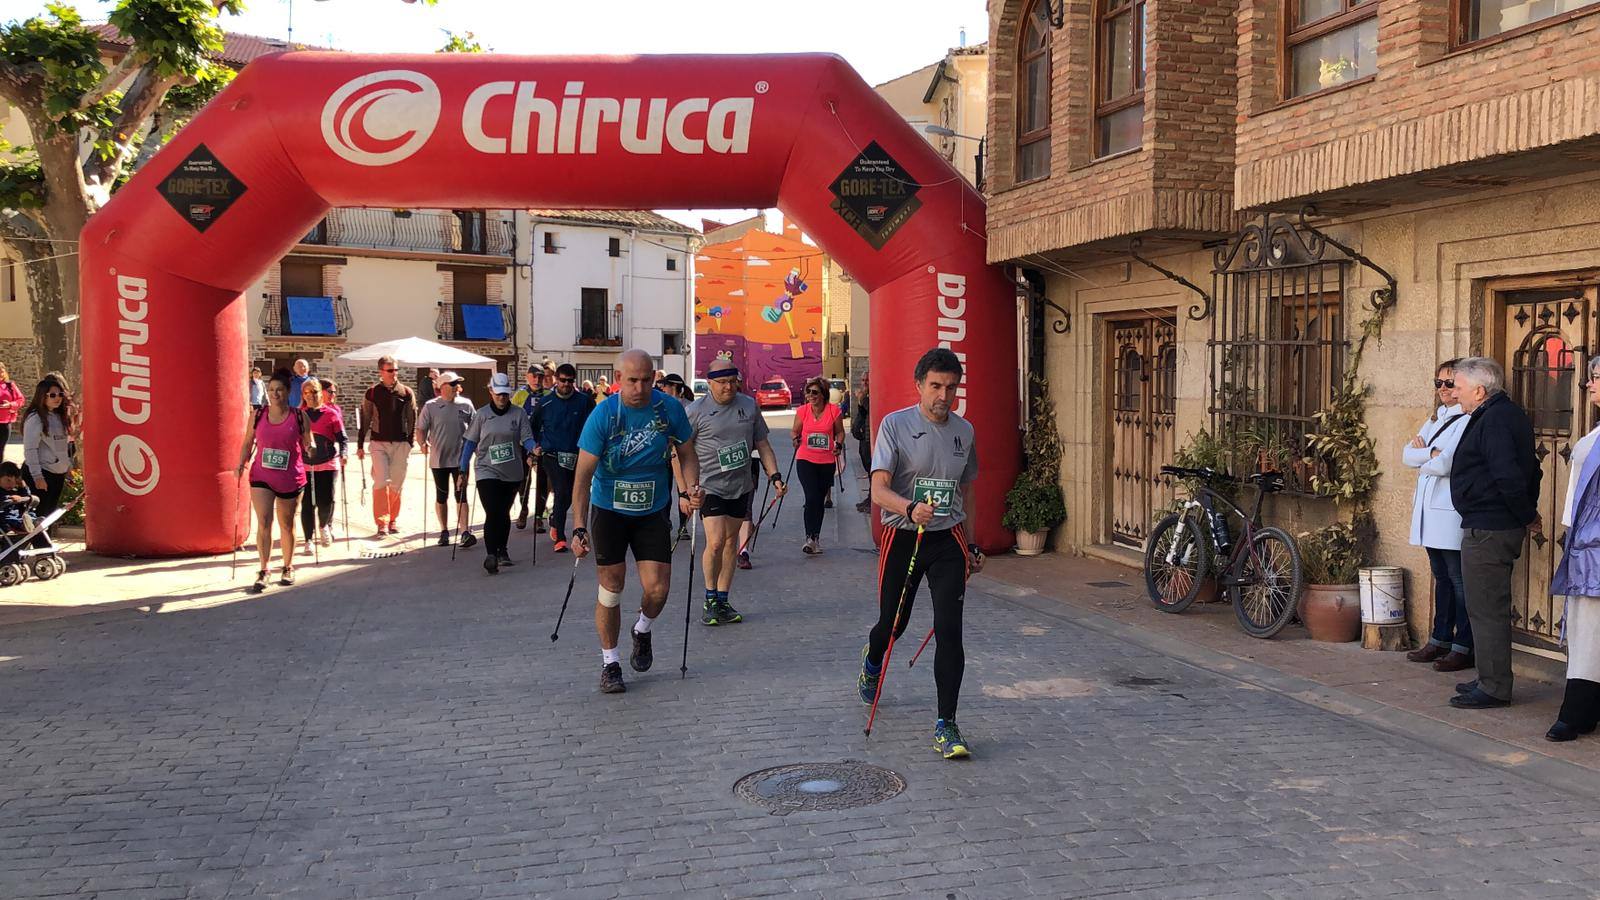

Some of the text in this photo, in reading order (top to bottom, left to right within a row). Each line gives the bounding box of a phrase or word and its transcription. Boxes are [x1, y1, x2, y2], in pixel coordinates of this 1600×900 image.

[460, 80, 755, 155] Chiruca
[840, 179, 906, 196] GORE-TEX
[111, 275, 151, 425] Chiruca
[267, 454, 283, 464] 159
[725, 450, 744, 463] 150
[622, 490, 647, 503] 163
[923, 490, 950, 507] 154
